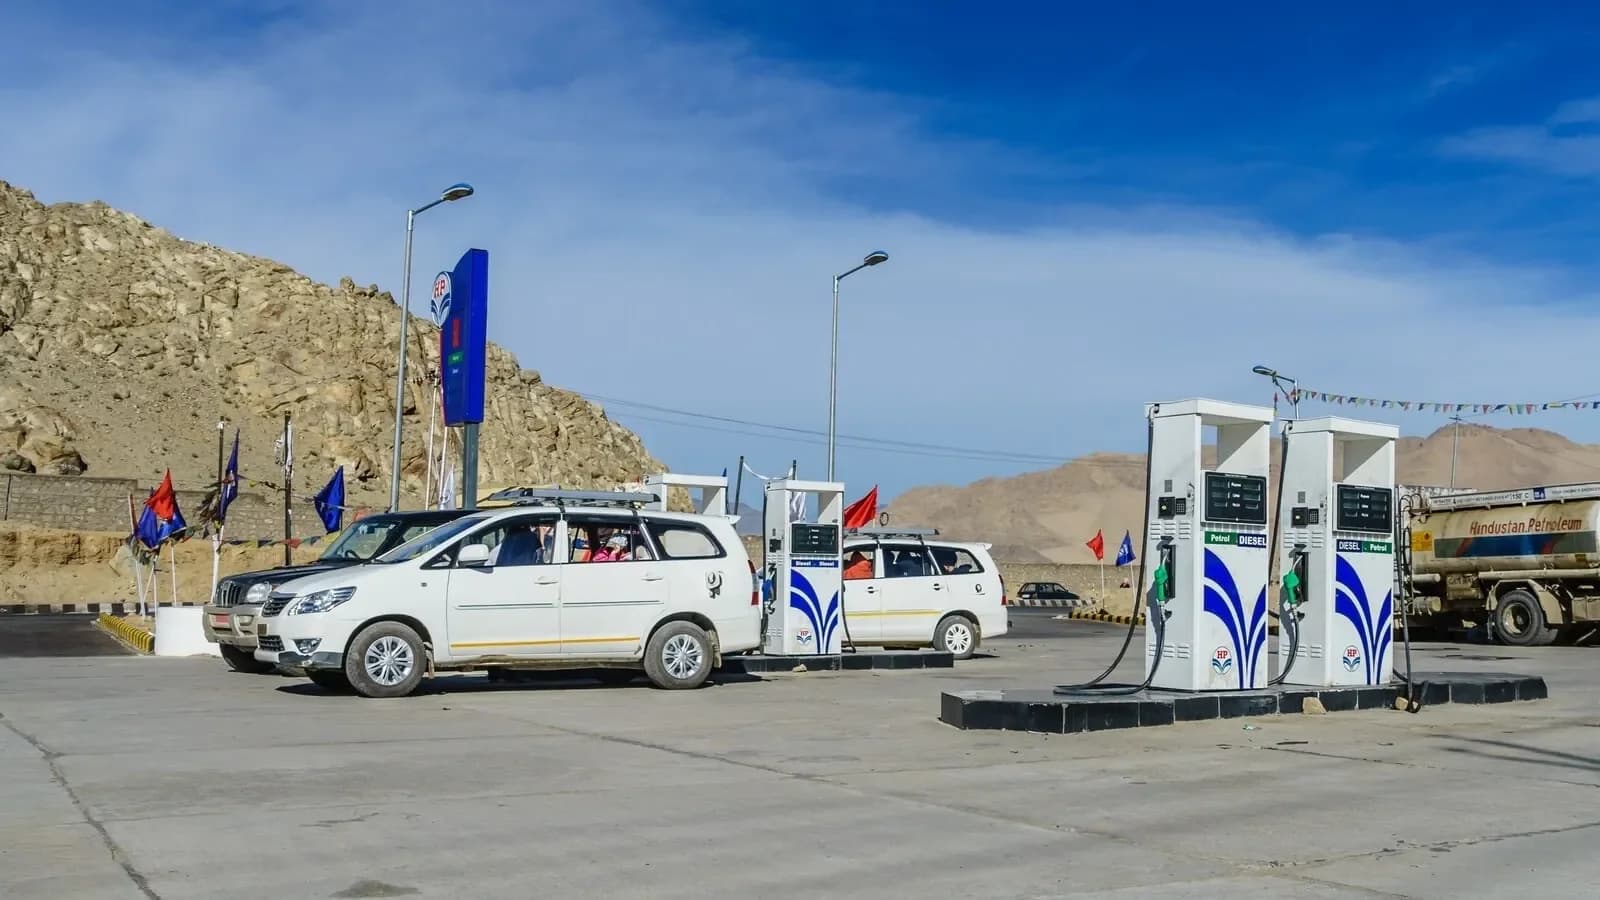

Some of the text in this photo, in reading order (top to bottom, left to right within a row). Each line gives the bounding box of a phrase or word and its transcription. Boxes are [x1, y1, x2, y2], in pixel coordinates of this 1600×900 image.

[434, 279, 446, 298] HP
[1469, 516, 1583, 536] Hindustan Petroleum
[1210, 534, 1231, 543] Petrol
[1239, 535, 1266, 546] DIESEL
[1338, 541, 1361, 550] DIESEL
[1369, 543, 1388, 552] Petrol
[1216, 650, 1228, 659] HP
[1346, 649, 1357, 657] HP
